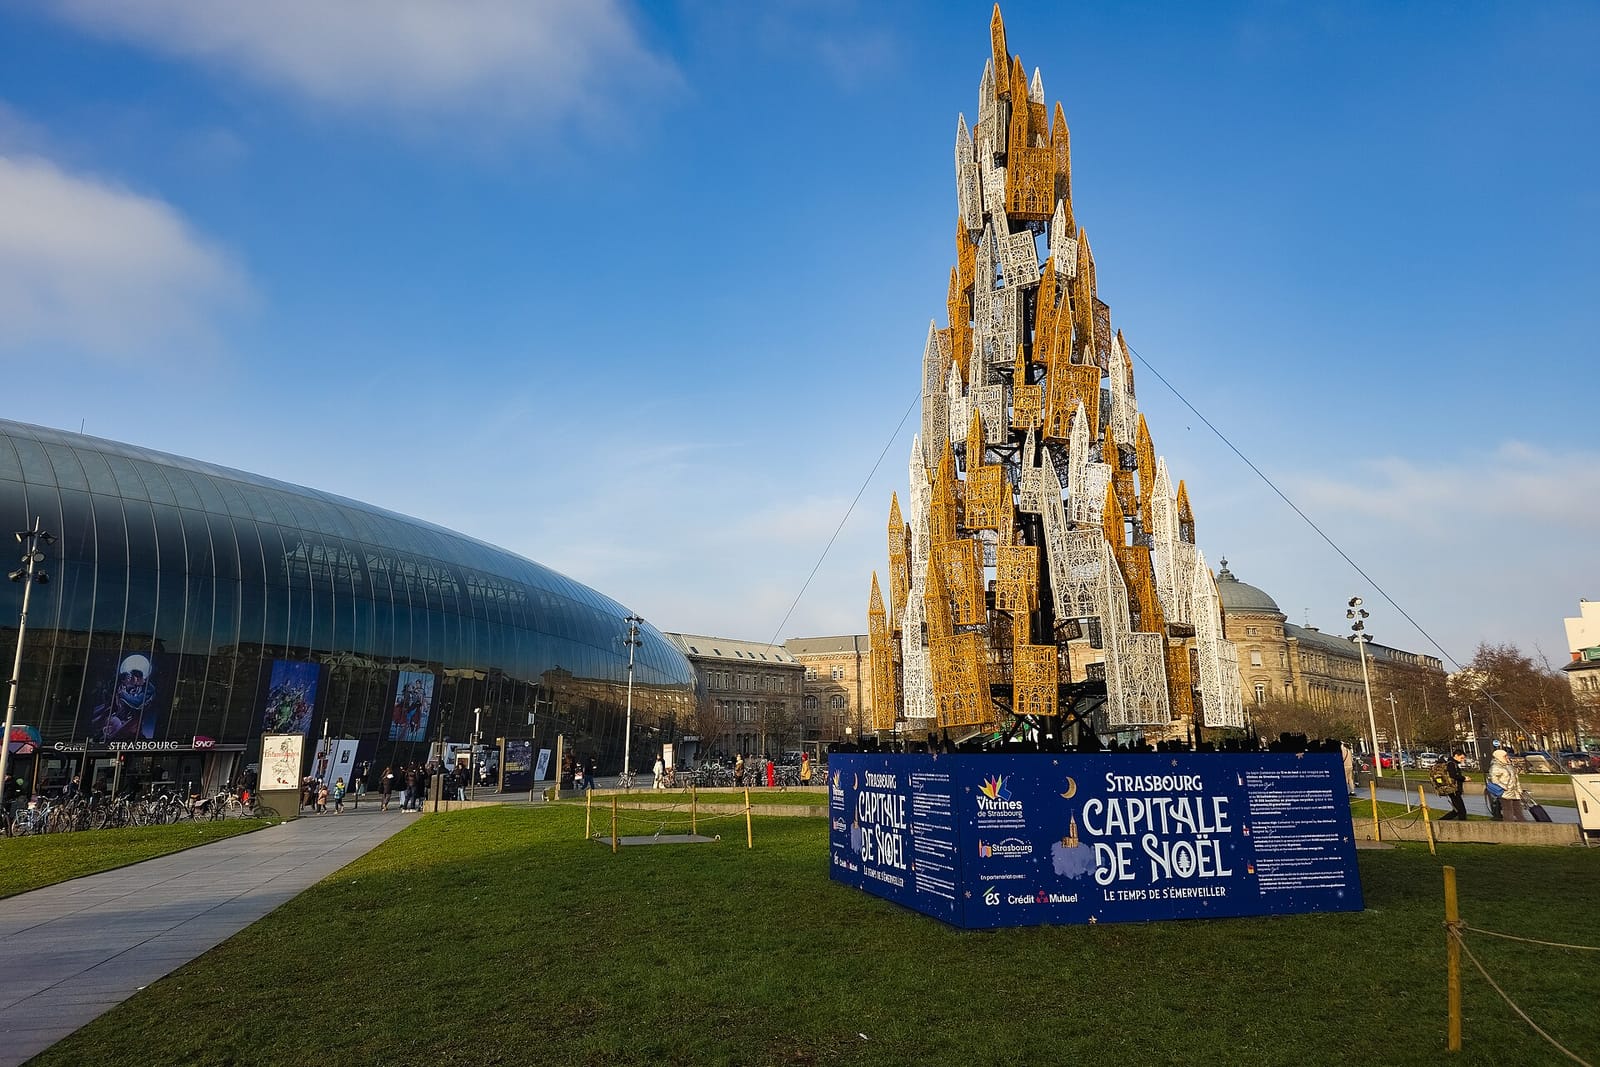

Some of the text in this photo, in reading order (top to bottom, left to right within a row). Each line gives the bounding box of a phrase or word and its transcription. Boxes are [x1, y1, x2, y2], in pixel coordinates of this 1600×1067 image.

[109, 741, 179, 750] STRASBOURG
[865, 770, 897, 789] STRASBOURG
[1105, 772, 1203, 792] STRASBOURG
[858, 791, 907, 830] CAPITALE
[977, 796, 1023, 810] Vitrines
[987, 811, 1023, 819] Strasbourg
[1082, 796, 1232, 836] CAPITALE
[861, 827, 874, 863] DE
[875, 823, 907, 870] NOËL
[992, 843, 1033, 853] Strasbourg
[1093, 842, 1136, 886] DE
[1141, 833, 1233, 883] NOËL
[1007, 893, 1078, 904] Crédit Mutuel
[1103, 886, 1226, 901] LE TEMPS DE S'ÉMERVEILLER
